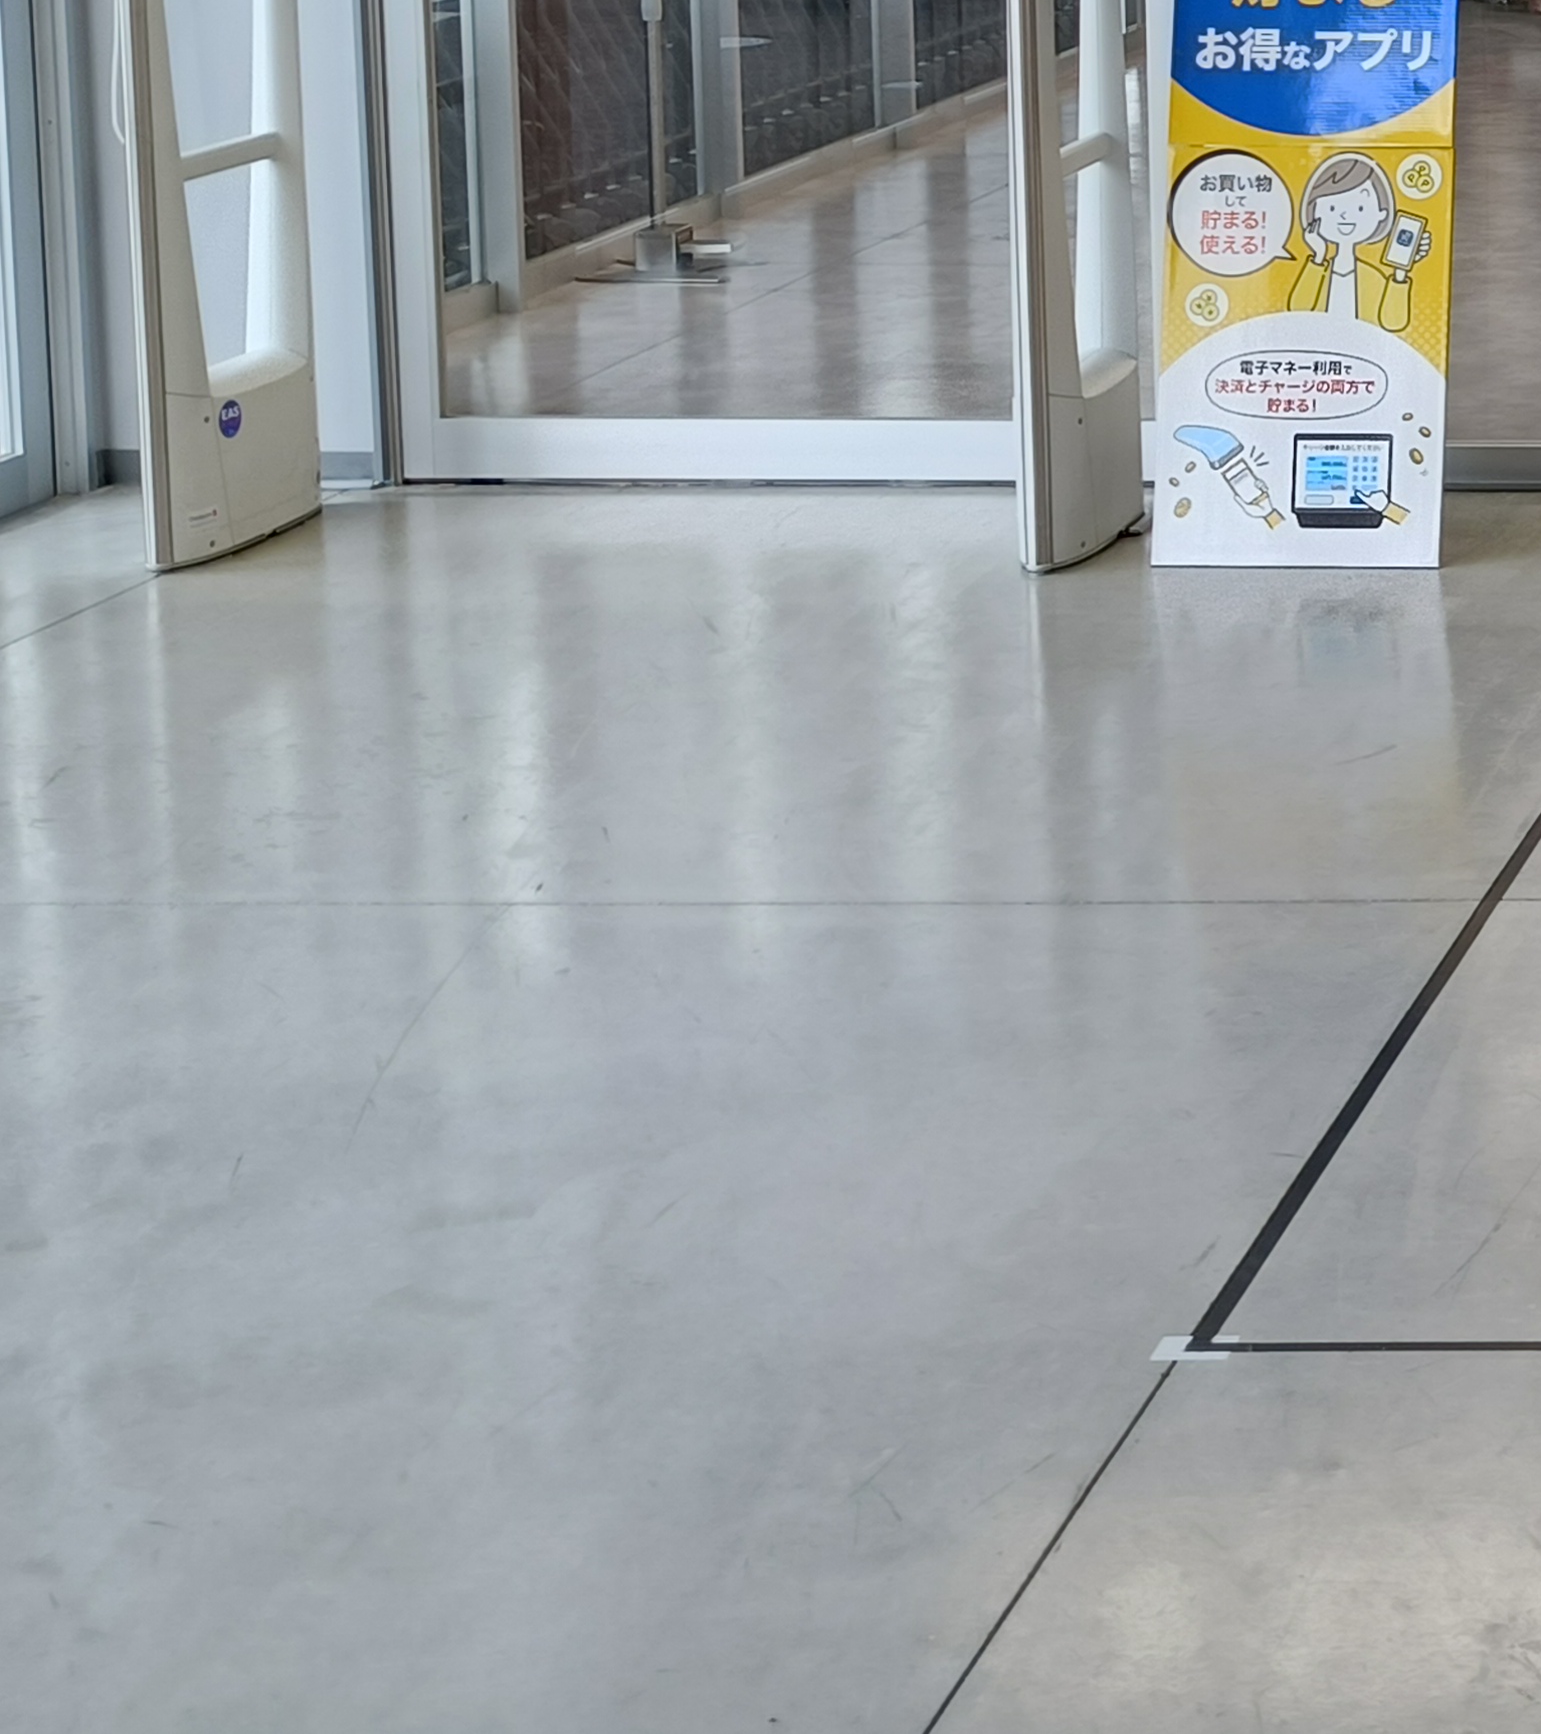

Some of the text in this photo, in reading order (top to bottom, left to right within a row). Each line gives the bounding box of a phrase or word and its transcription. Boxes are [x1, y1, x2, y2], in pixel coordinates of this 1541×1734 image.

[1195, 27, 1433, 72] お得なアプリ
[1200, 174, 1272, 193] お買い物
[1225, 195, 1247, 207] して
[1201, 210, 1266, 229] 貯まる!
[1200, 235, 1266, 254] 使える!
[1240, 360, 1352, 375] 電子マネー利用で
[1215, 379, 1375, 394] 決済とチャージの両方で
[1267, 398, 1316, 413] 貯まる!
[221, 406, 240, 421] EAS
